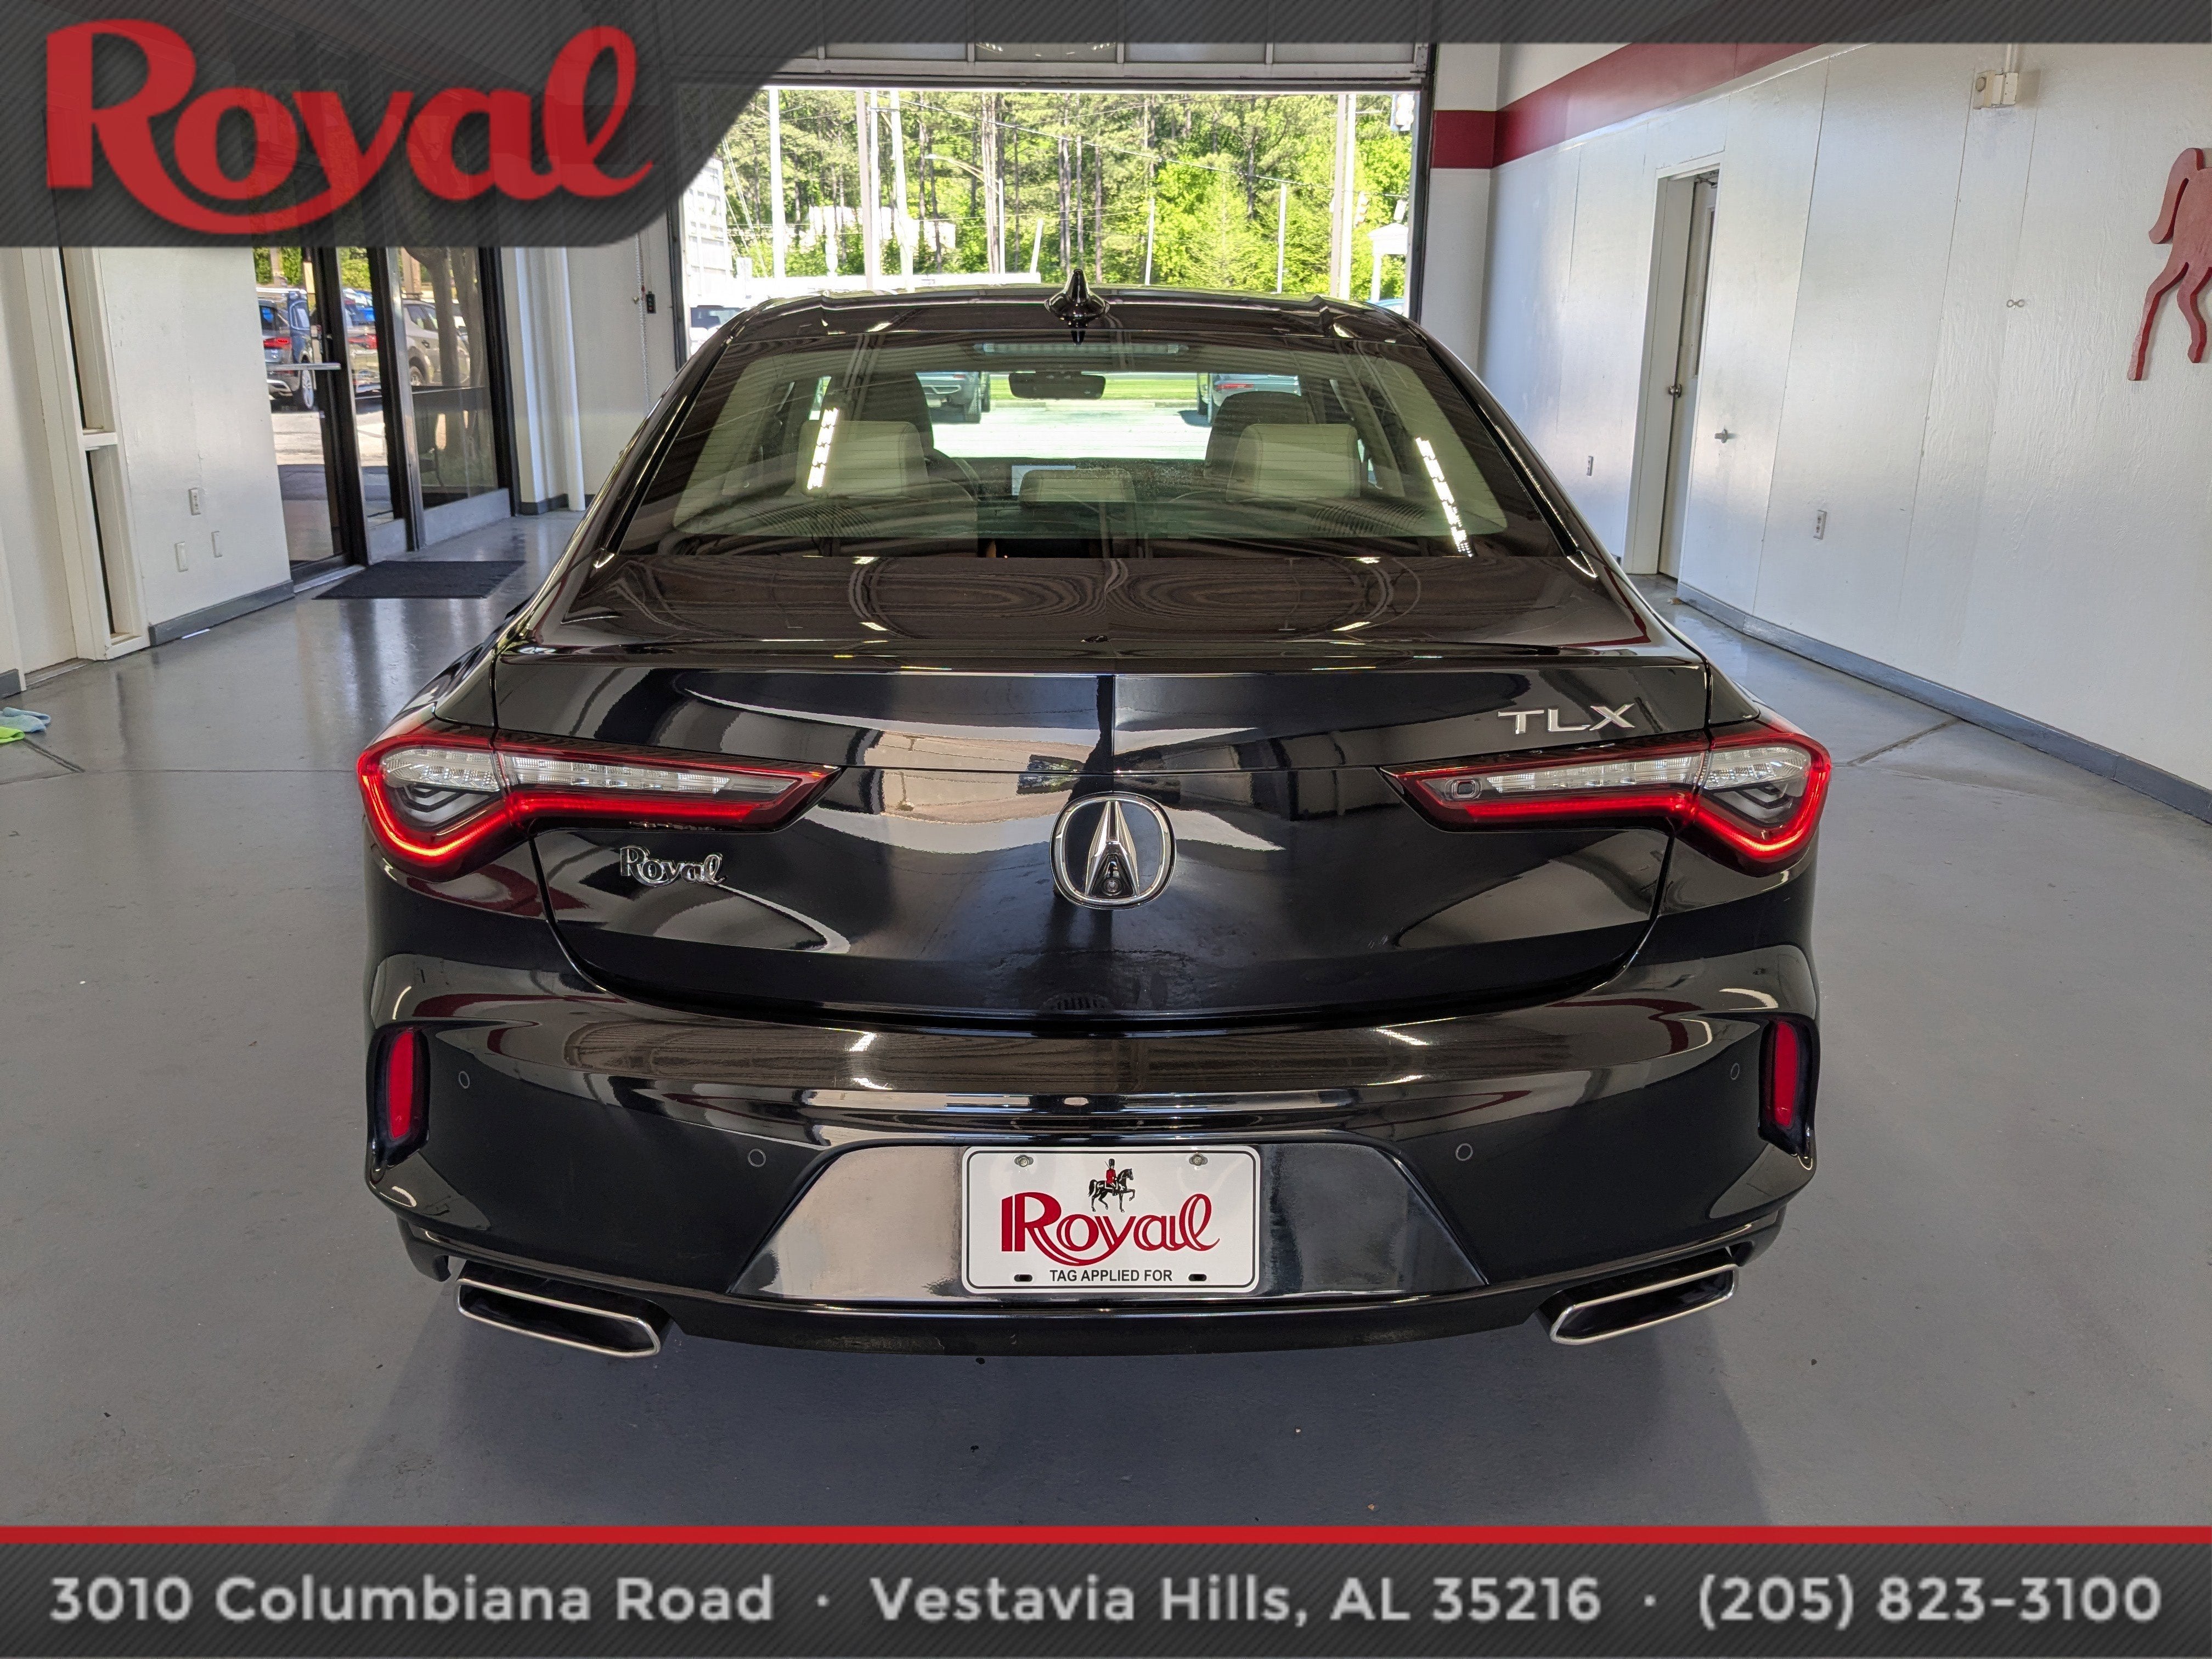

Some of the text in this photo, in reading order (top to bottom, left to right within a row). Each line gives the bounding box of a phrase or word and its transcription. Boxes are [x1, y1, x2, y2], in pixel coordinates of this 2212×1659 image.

[1497, 703, 1635, 735] TLX
[620, 845, 727, 887] Royal
[1001, 1192, 1220, 1267] Royal
[1049, 1269, 1172, 1282] TAG APPLIED FOR
